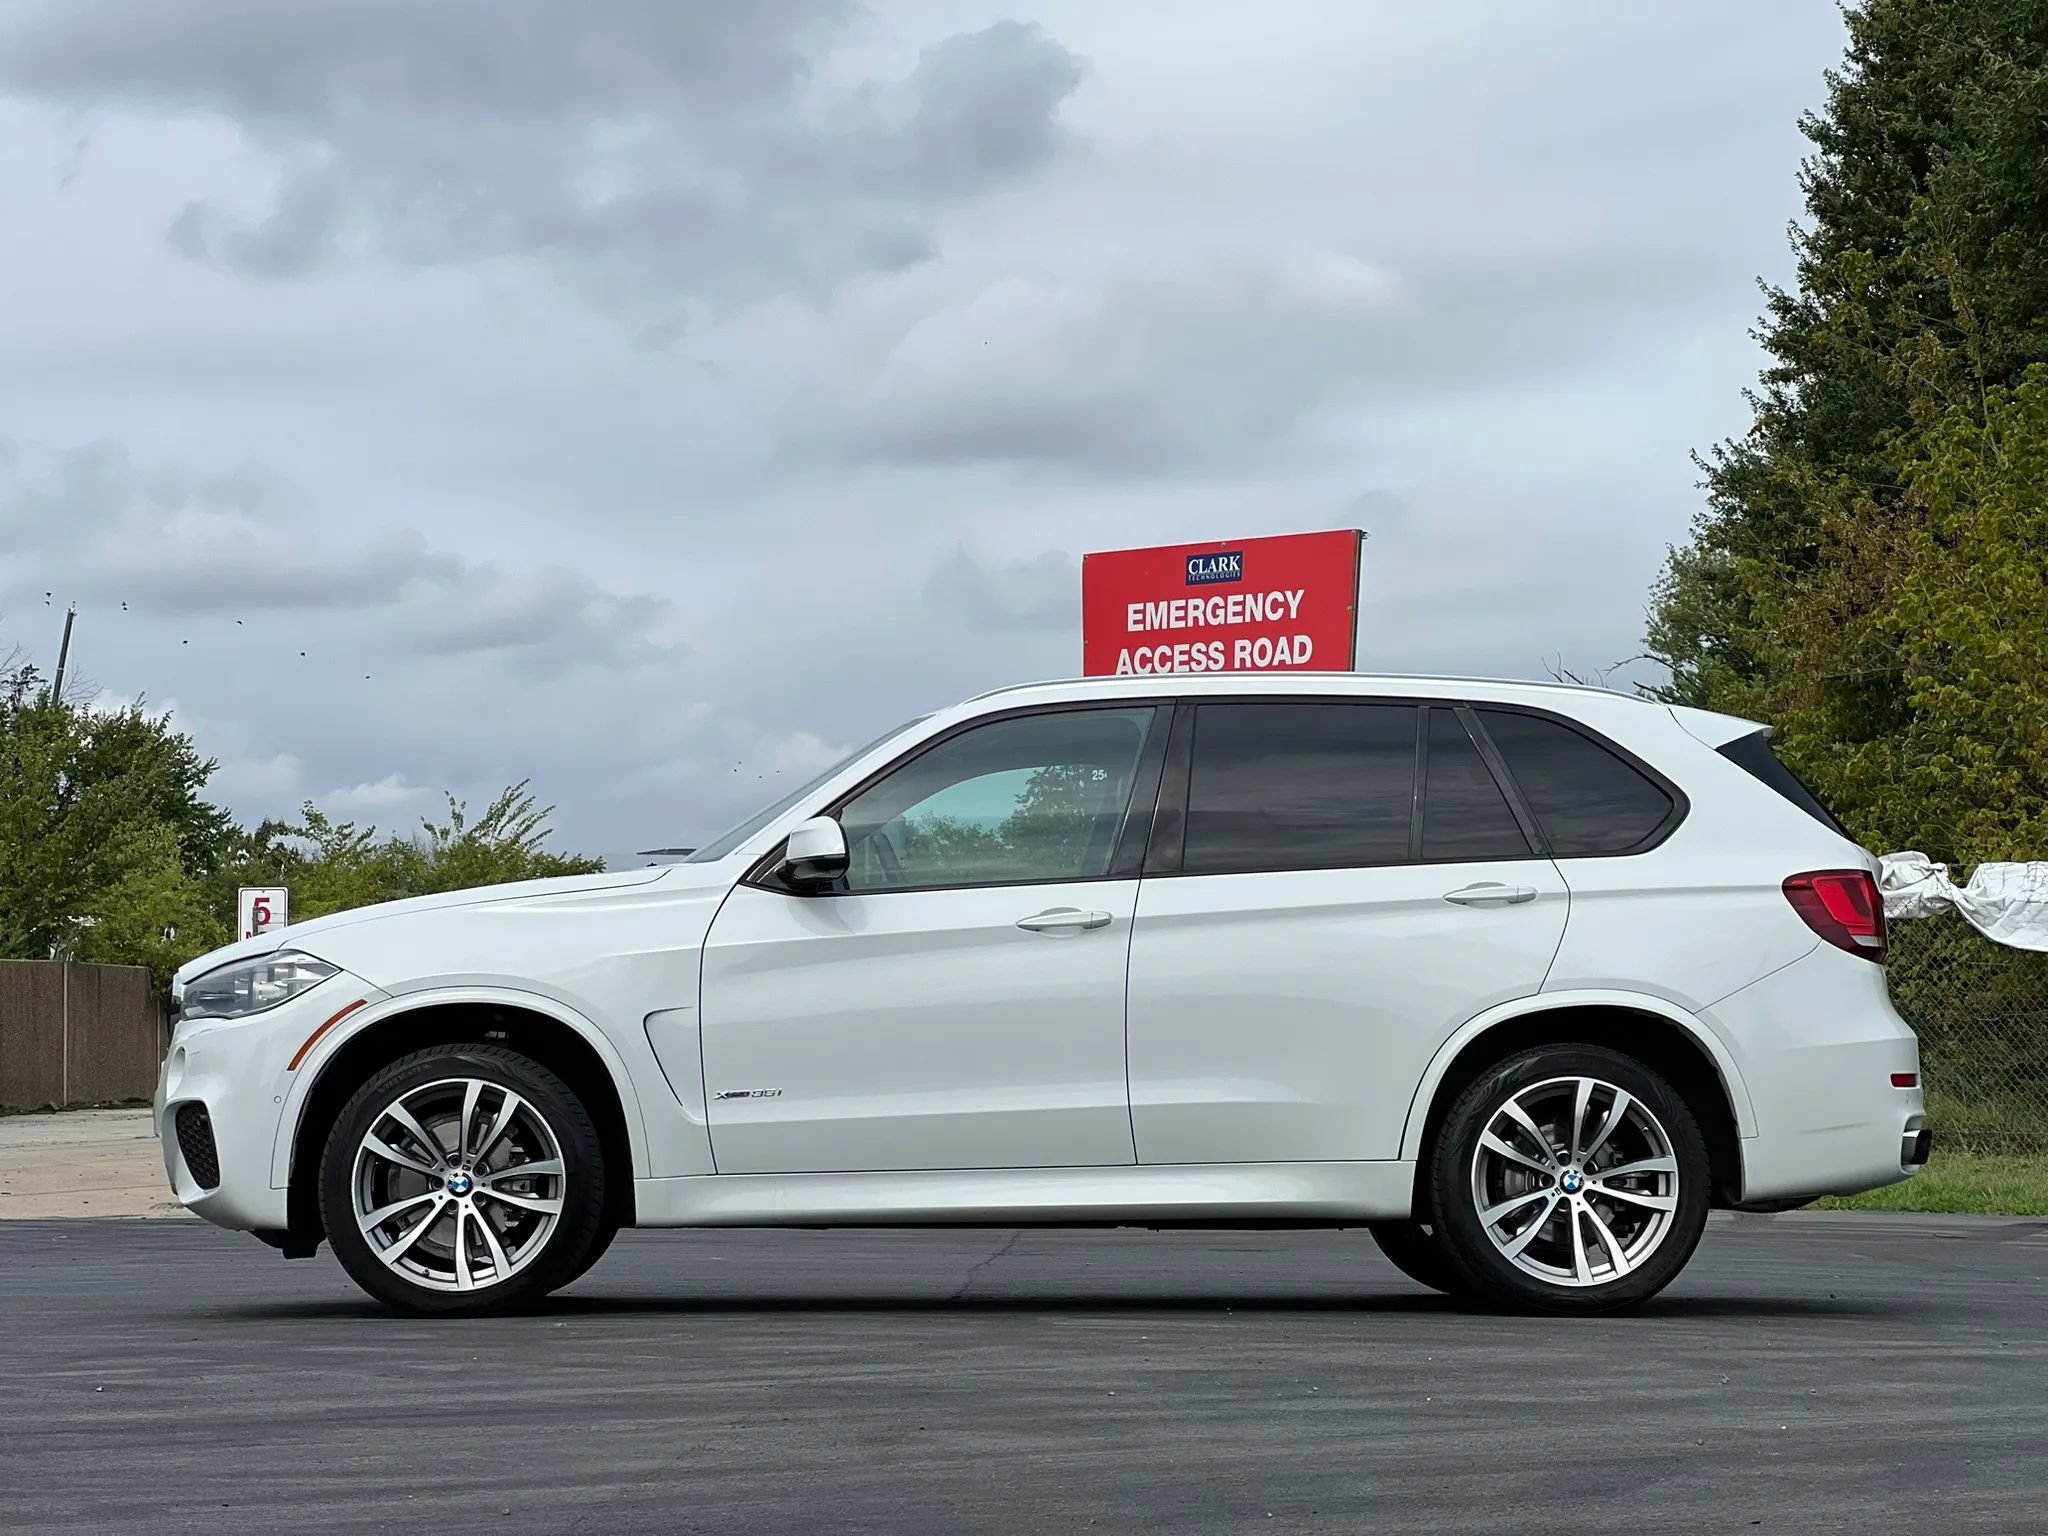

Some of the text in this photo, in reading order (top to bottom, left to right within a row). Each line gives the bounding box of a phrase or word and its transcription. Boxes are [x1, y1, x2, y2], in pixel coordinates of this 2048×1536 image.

[1188, 555, 1241, 575] CLARK
[1188, 571, 1241, 582] TECHNOLOGIES
[1127, 589, 1305, 632] EMERGENCY
[1115, 634, 1313, 676] ACCESS ROAD
[253, 897, 271, 926] 5
